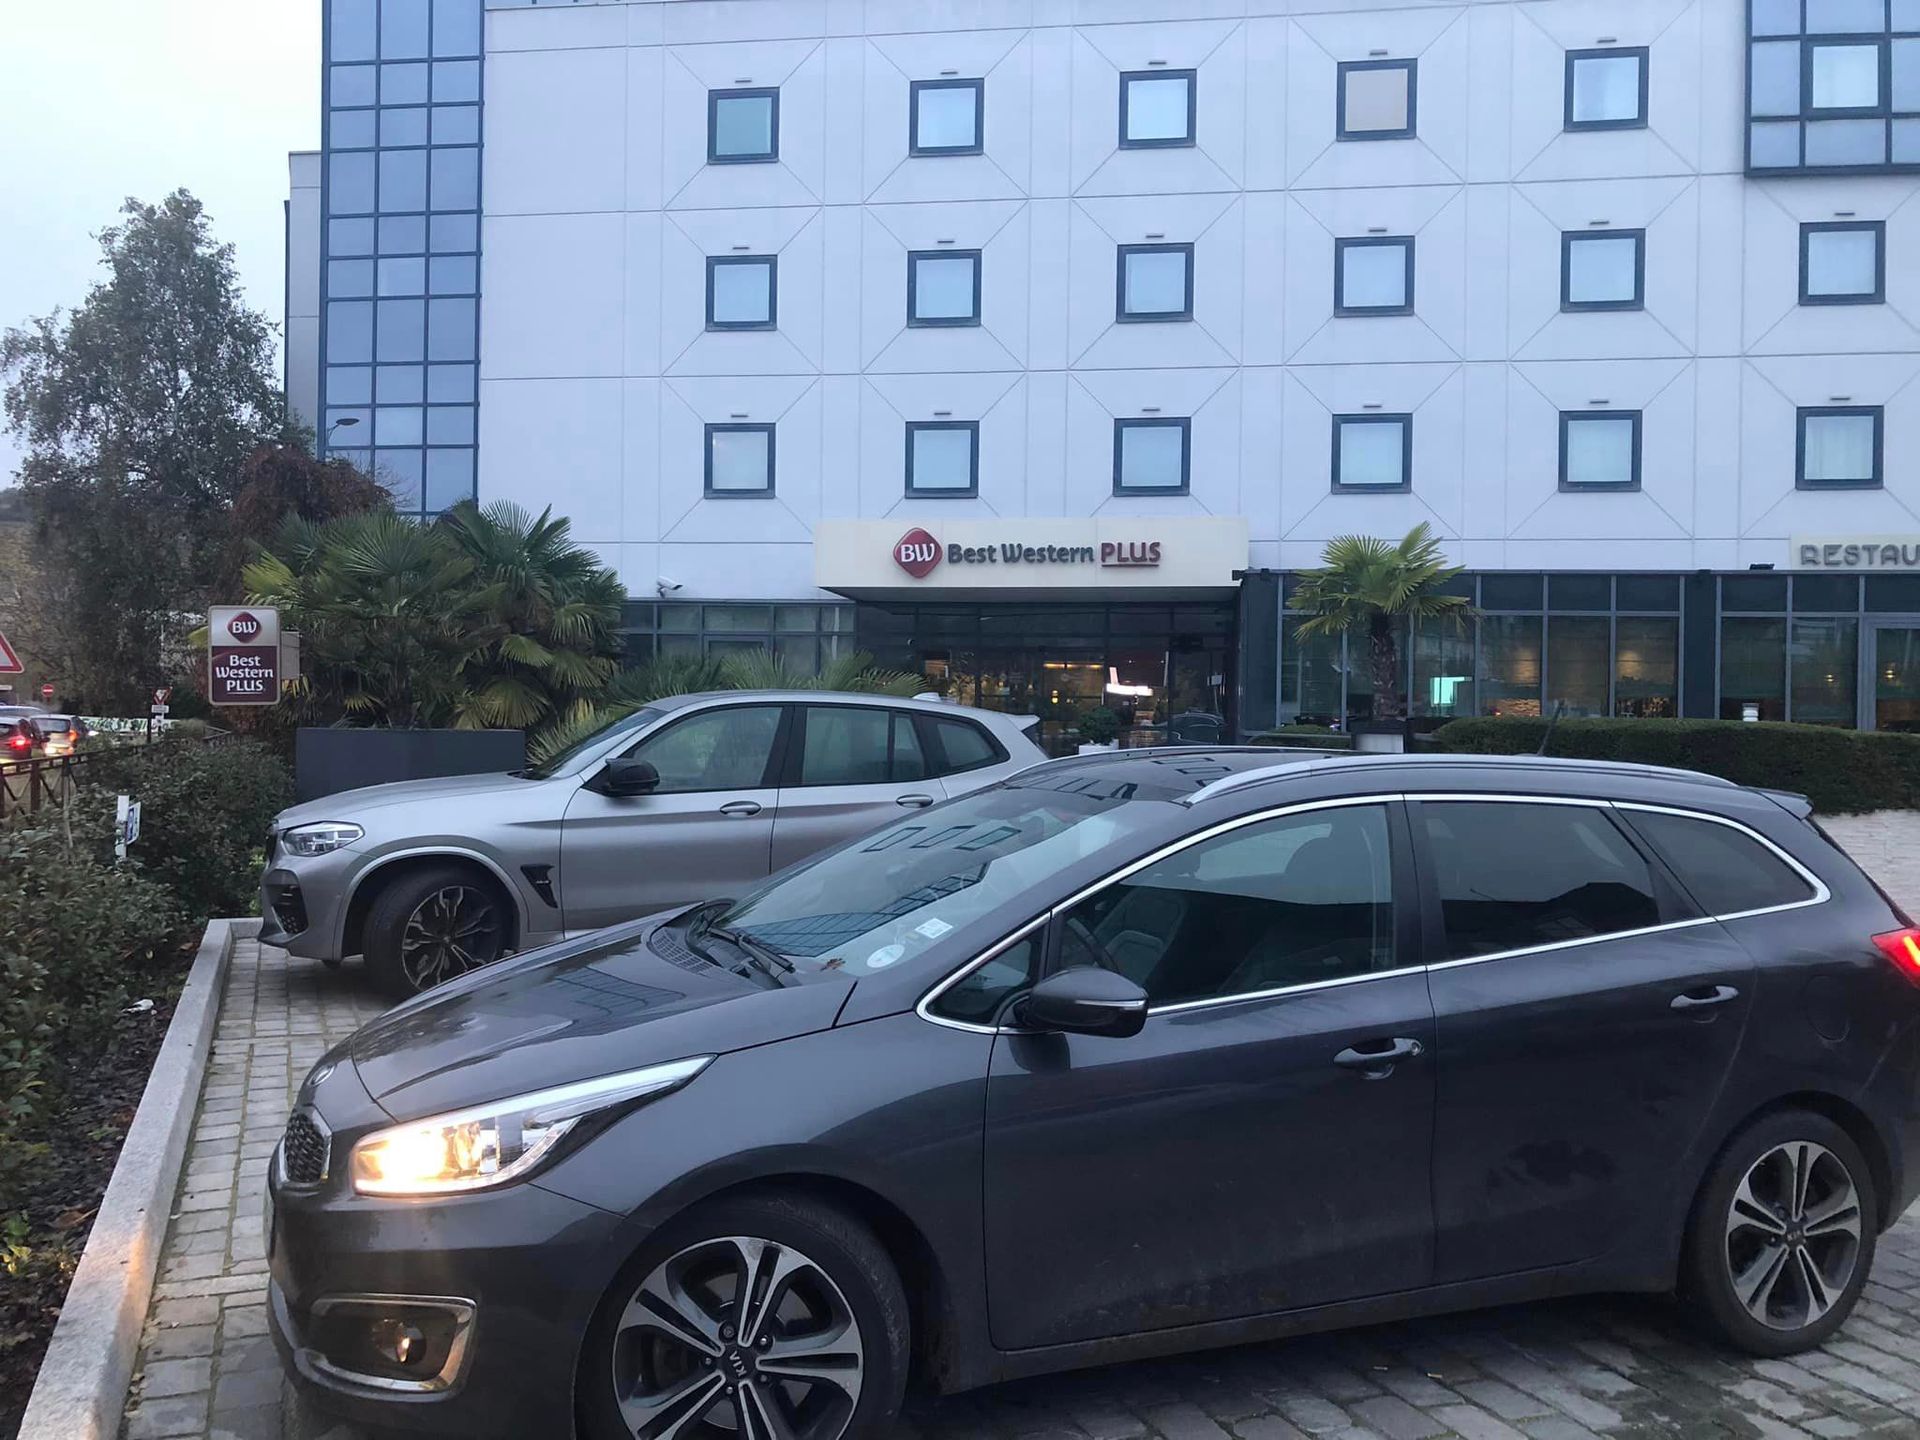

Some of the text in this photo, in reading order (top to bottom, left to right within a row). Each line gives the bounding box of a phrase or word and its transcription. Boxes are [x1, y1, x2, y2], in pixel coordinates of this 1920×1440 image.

[901, 543, 935, 562] BW
[947, 542, 1161, 564] Best Western PLUS
[1800, 544, 1920, 566] RESTAU
[232, 621, 257, 634] BW
[229, 655, 261, 667] Best
[215, 667, 274, 678] Western
[226, 680, 264, 692] PLUS
